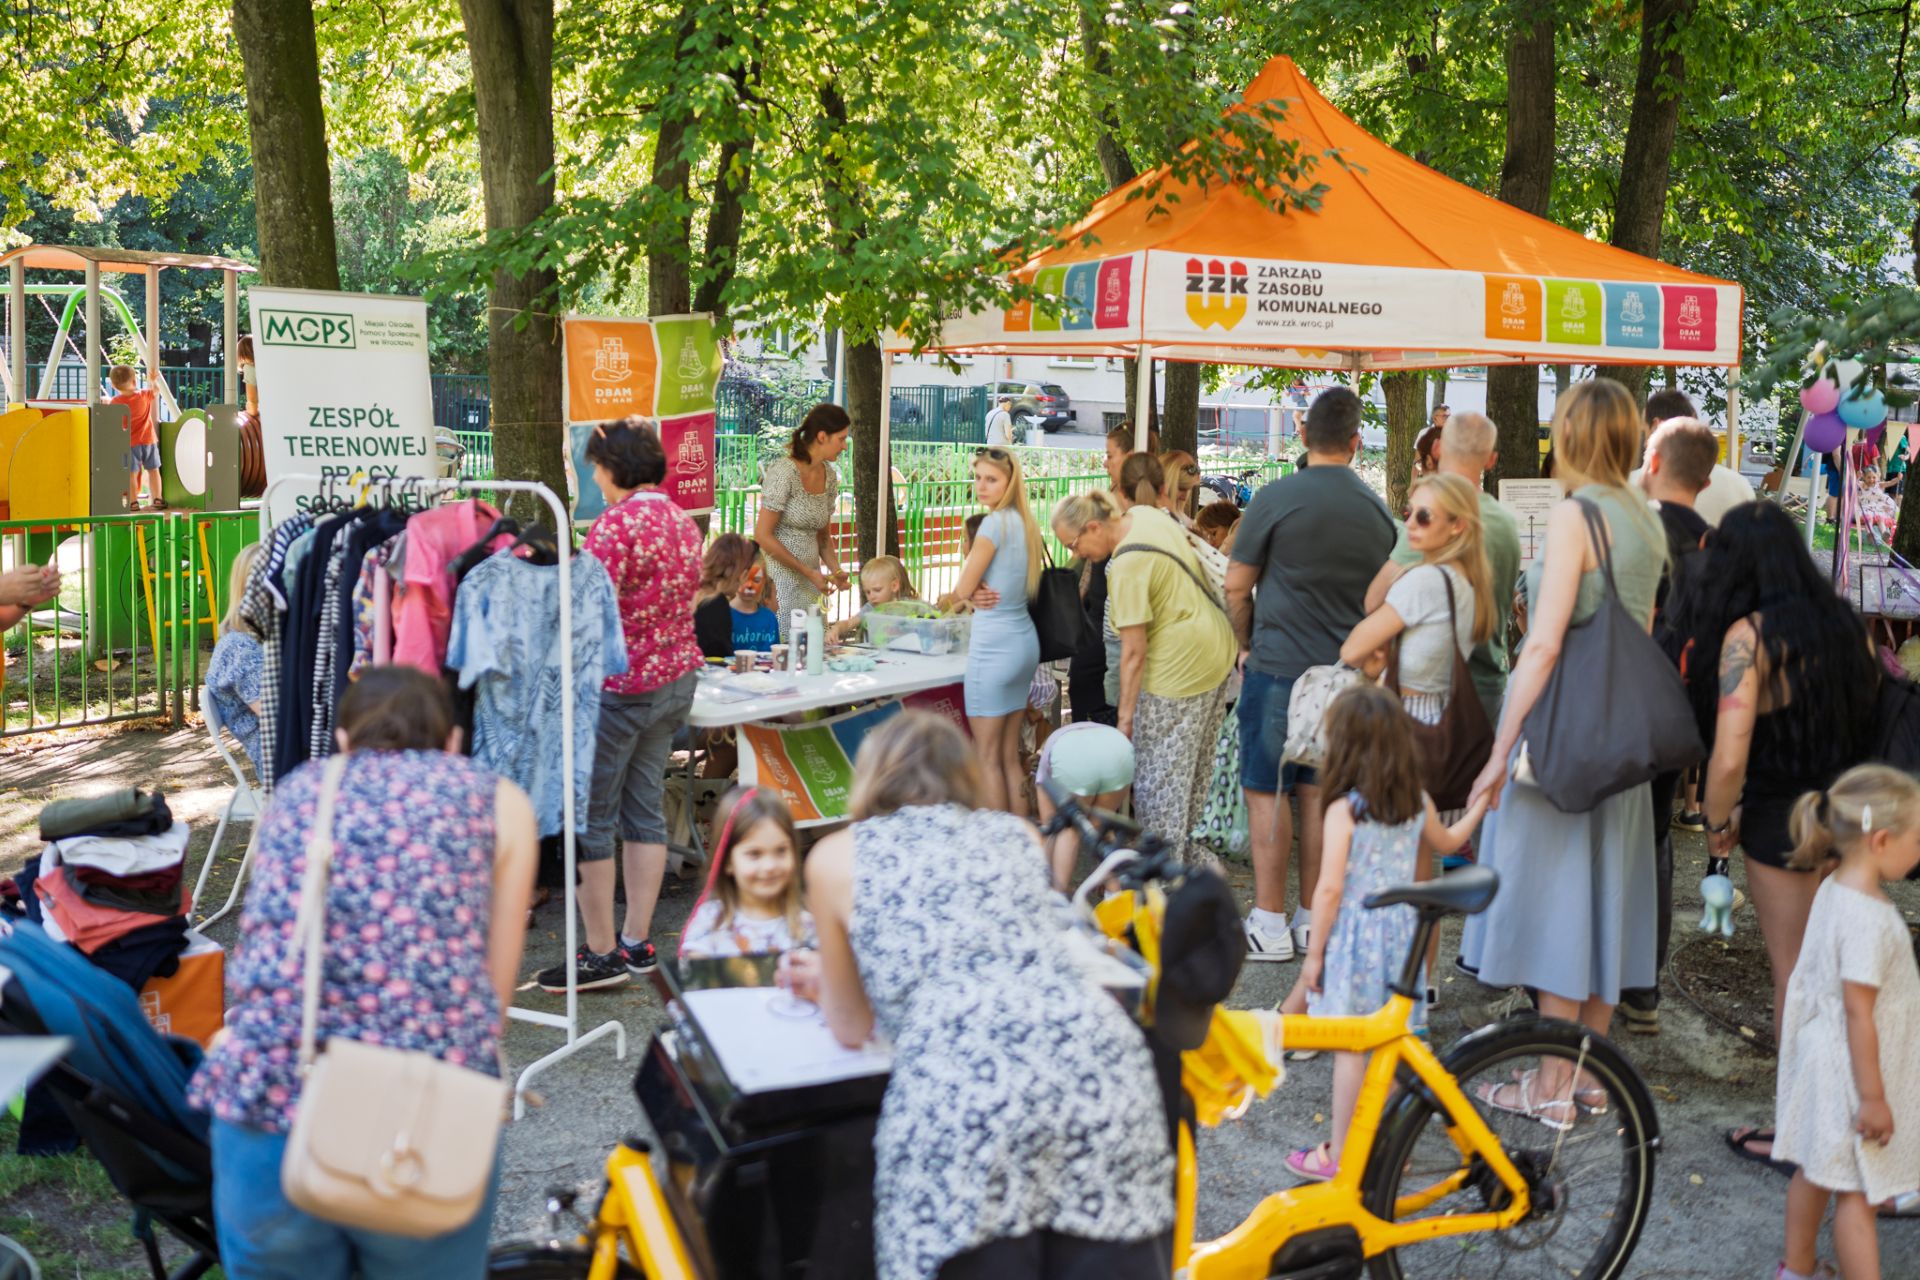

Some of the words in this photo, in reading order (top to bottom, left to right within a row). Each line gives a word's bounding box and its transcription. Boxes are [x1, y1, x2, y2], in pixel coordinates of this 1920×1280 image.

[1257, 265, 1322, 282] ZARZĄD
[1185, 275, 1249, 294] ZZK
[1257, 282, 1323, 296] ZASOBU
[1257, 299, 1383, 315] KOMUNALNEGO
[265, 315, 351, 344] MOPS
[1680, 328, 1701, 336] DBAM
[595, 386, 632, 398] DBAM
[308, 403, 400, 428] ZESPÓŁ
[283, 436, 427, 456] TERENOWEJ
[677, 478, 707, 489] DBAM
